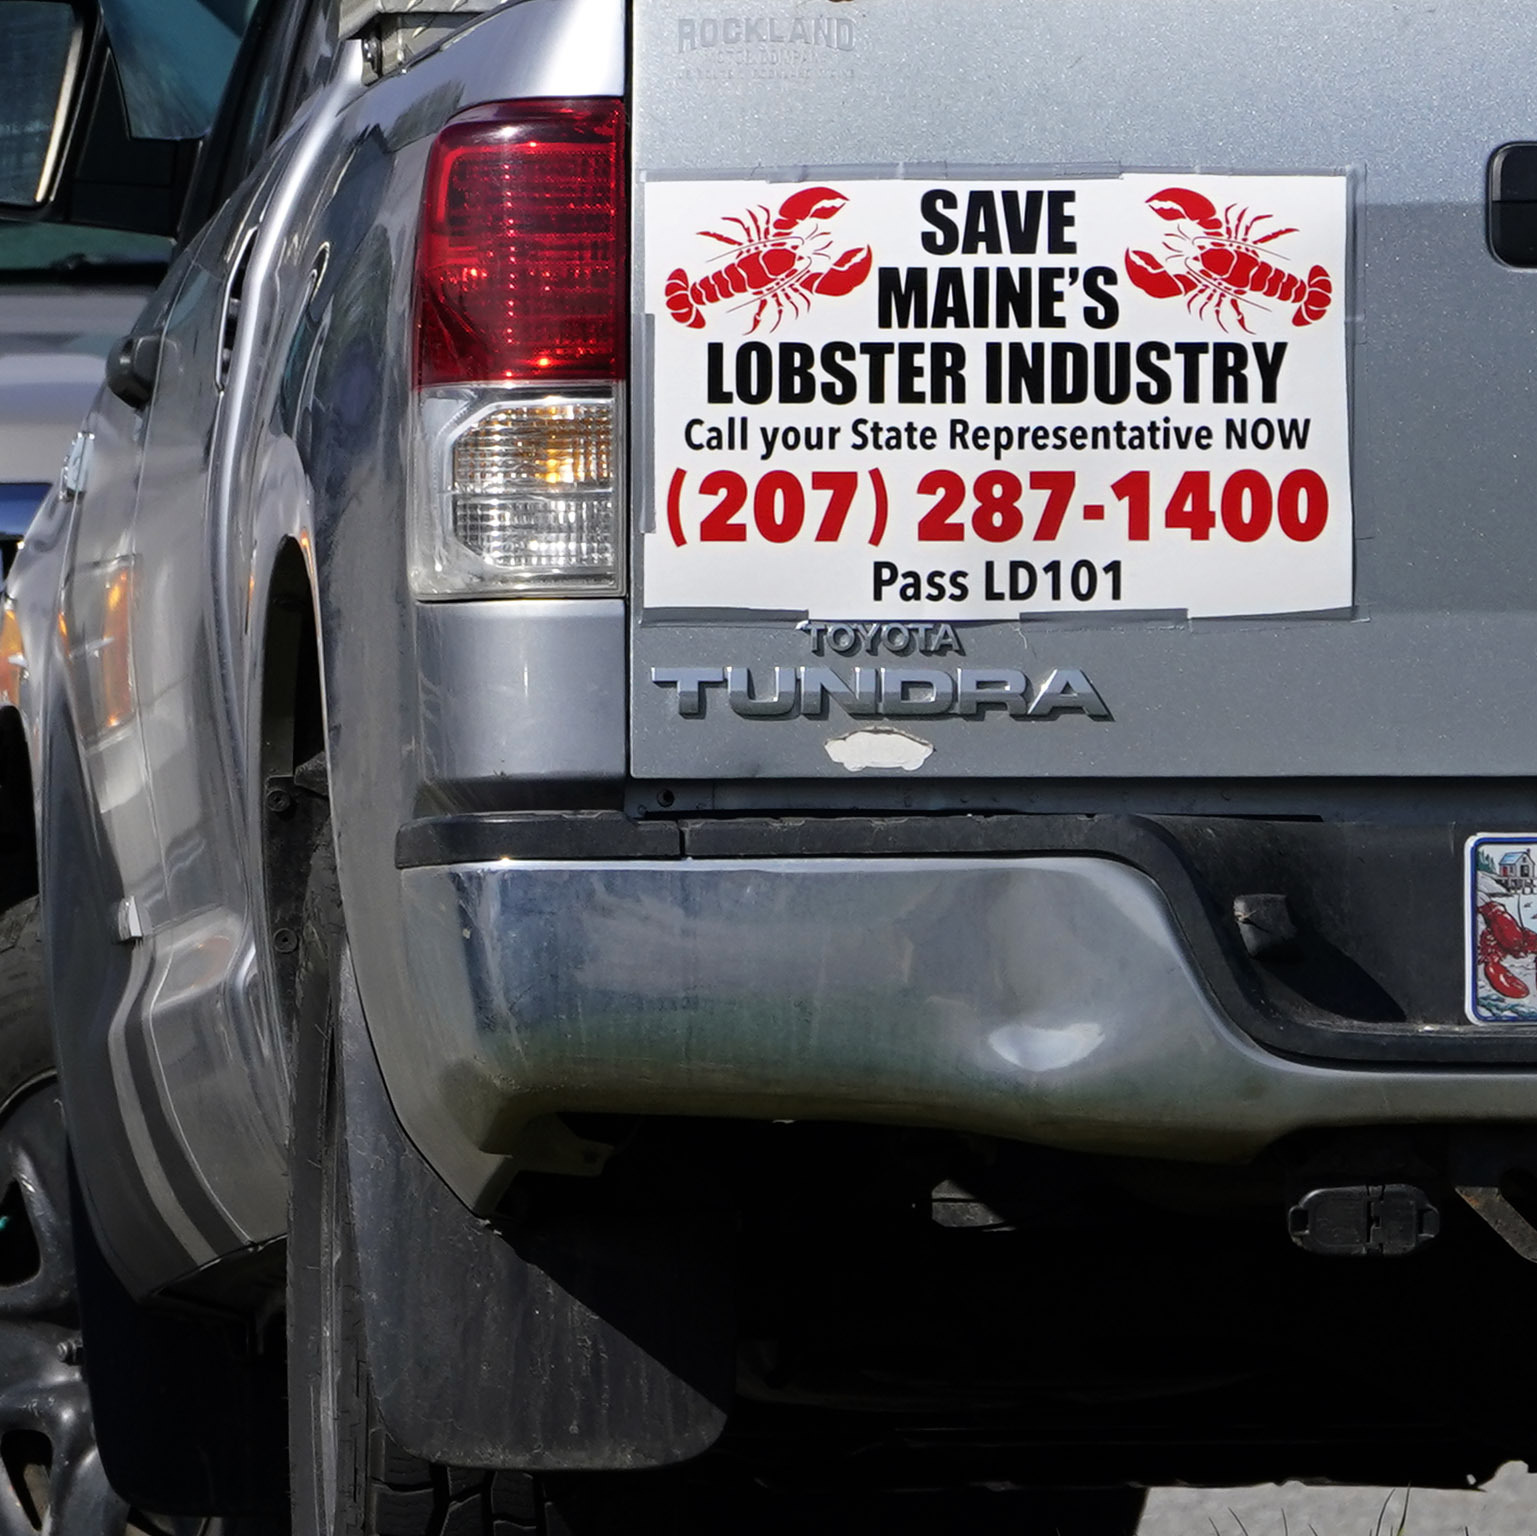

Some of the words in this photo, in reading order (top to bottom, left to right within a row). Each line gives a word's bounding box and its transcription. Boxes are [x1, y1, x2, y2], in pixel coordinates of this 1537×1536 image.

[677, 16, 857, 53] ROCKLAND
[919, 189, 1077, 256] SAVE
[877, 266, 1120, 330] MAINE'S
[707, 341, 967, 405] LOBSTER
[986, 341, 1289, 405] INDUSTRY
[684, 417, 748, 451] Call
[760, 426, 841, 461] your
[851, 419, 937, 451] State
[950, 416, 1213, 461] Representative
[1225, 417, 1311, 451] NOW
[667, 468, 888, 547] (207)
[916, 468, 1330, 544] 287-1400
[873, 561, 969, 602] Pass
[985, 559, 1123, 602] LD101
[805, 622, 963, 654] TOYOTA
[650, 667, 1113, 721] TUNDRA
